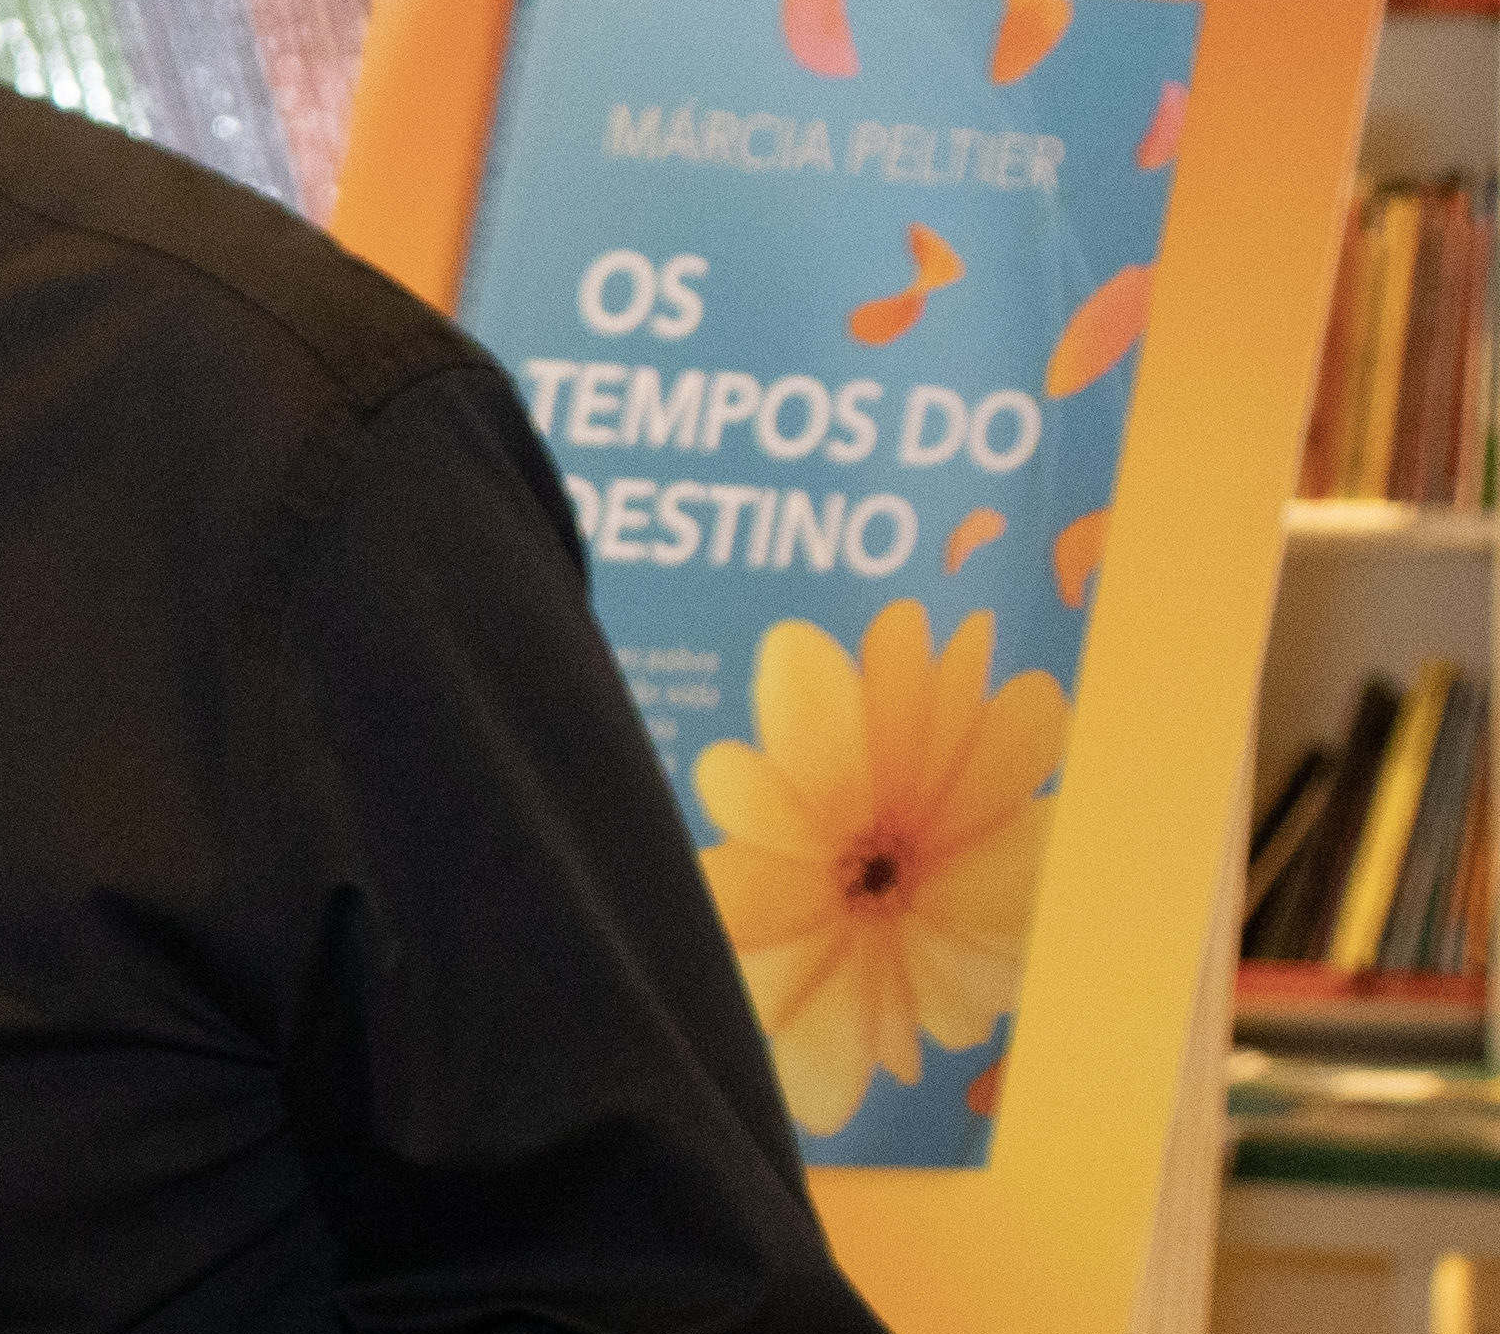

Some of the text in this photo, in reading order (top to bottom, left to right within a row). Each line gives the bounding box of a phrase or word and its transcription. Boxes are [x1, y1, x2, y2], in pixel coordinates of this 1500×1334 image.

[606, 97, 1066, 194] MÁRCIA PELTIER
[577, 249, 709, 340] OS
[524, 357, 1042, 474] TEMPOS DO
